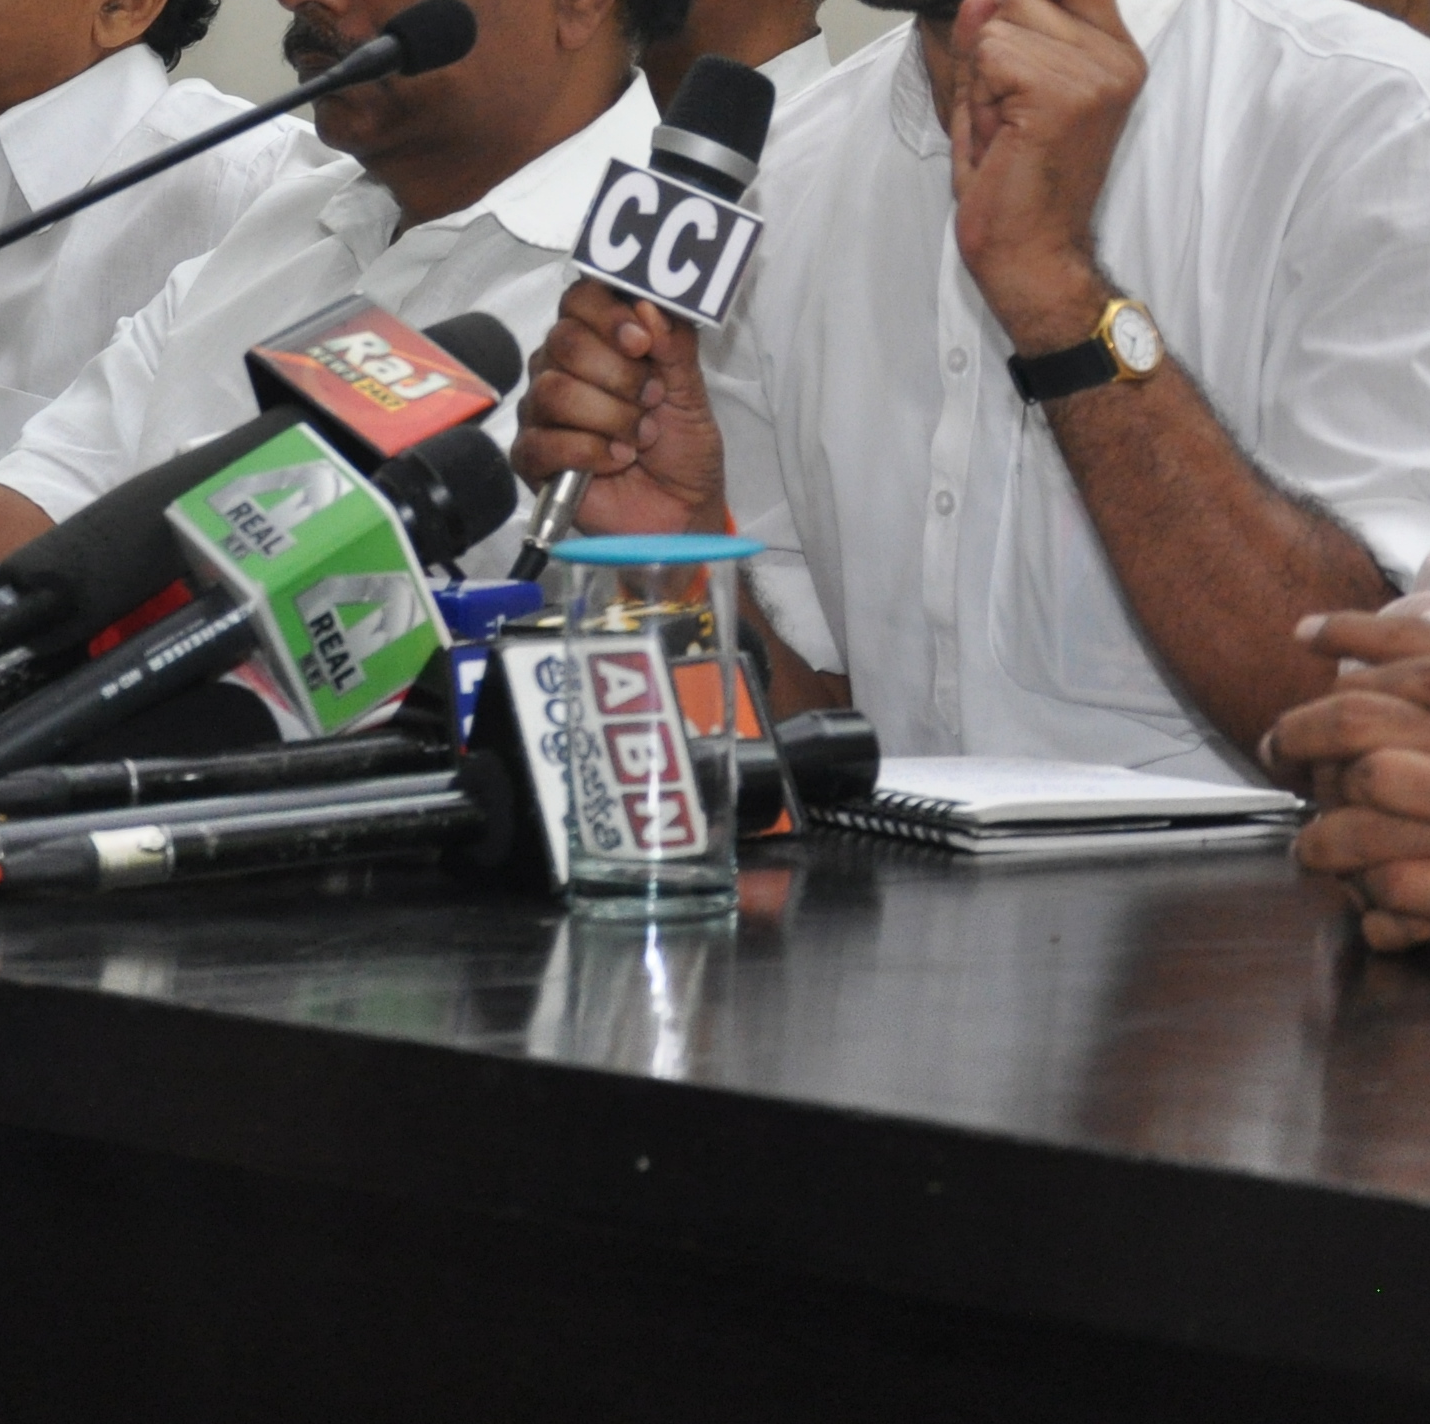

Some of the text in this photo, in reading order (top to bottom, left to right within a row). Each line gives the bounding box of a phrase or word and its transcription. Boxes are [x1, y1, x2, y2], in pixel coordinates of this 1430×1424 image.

[589, 171, 756, 317] CCI
[226, 501, 285, 556] REAL
[310, 612, 357, 692] REAL
[594, 657, 691, 847] ABN
